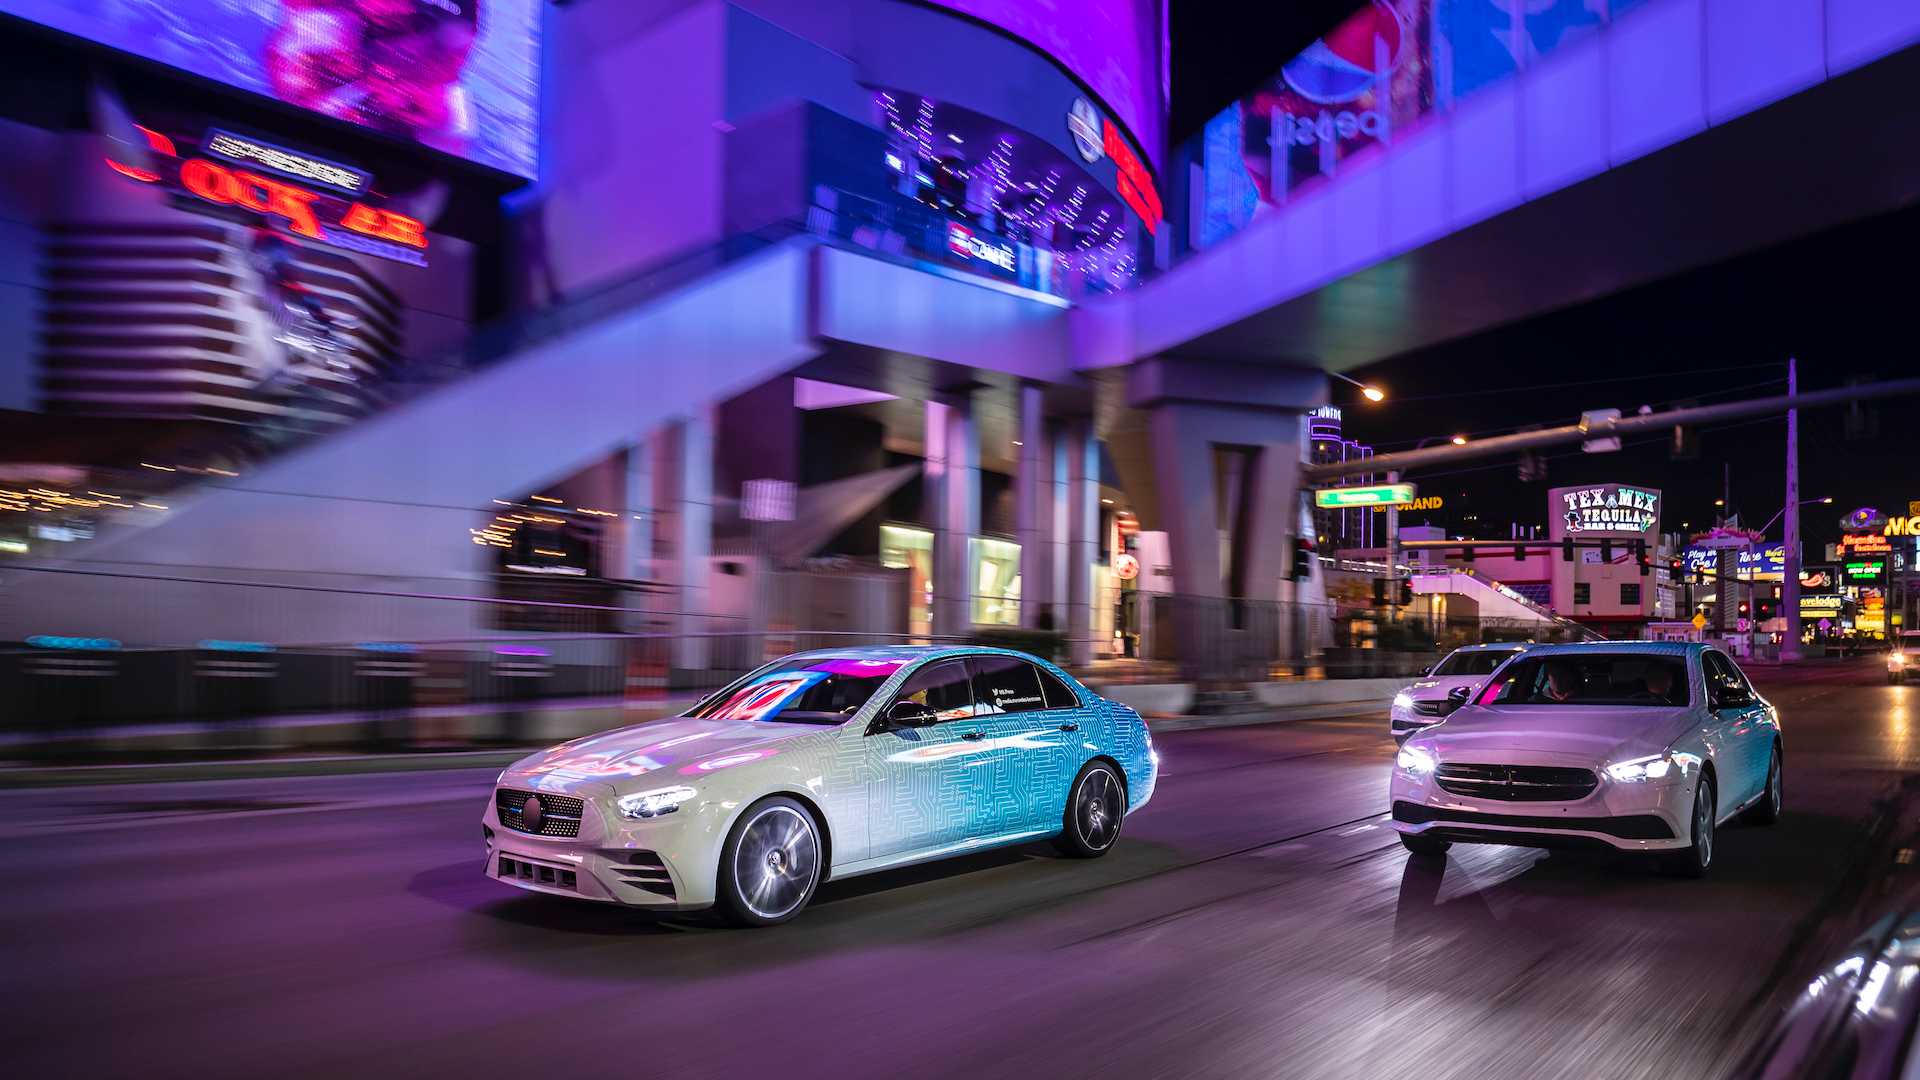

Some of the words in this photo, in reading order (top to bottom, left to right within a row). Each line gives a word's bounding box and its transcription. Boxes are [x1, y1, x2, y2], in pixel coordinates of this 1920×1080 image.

[1563, 488, 1605, 511] TEX
[1618, 488, 1657, 513] MEX
[1583, 509, 1640, 523] TEQUILA
[1583, 522, 1605, 531] BAR
[1615, 522, 1640, 531] GRILL
[1800, 596, 1841, 608] avelodge
